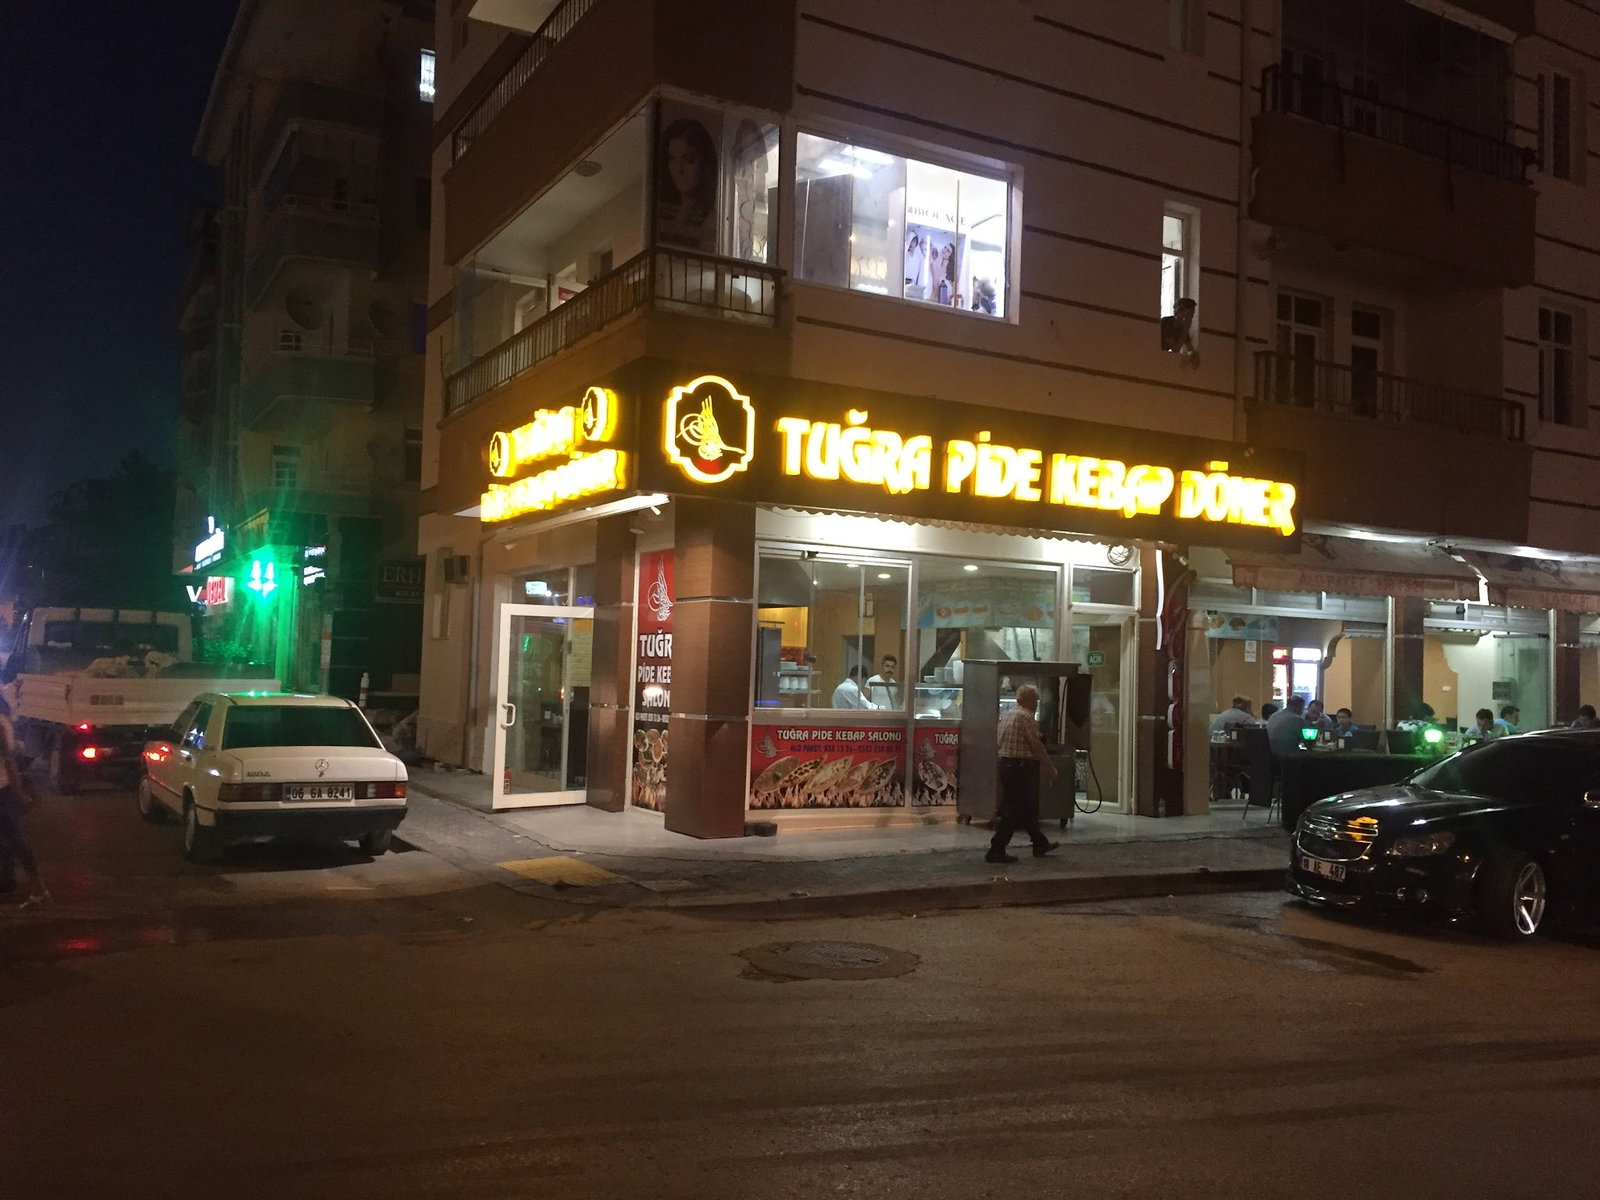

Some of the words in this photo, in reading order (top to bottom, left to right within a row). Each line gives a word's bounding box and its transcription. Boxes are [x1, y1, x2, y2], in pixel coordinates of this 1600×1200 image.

[777, 408, 933, 495] TUĞRA
[945, 430, 1042, 502] PİDE
[1048, 453, 1175, 519] KEBAP
[1177, 461, 1297, 537] DÖNER
[640, 628, 673, 660] TUĞR
[638, 662, 655, 683] PİDE
[642, 687, 671, 708] SALON
[777, 728, 809, 741] TUĞRA
[811, 728, 833, 741] PİDE
[835, 730, 866, 741] KEBAP
[868, 731, 901, 742] SALONU
[934, 731, 960, 745] TUĞRA
[291, 788, 304, 799] 06
[327, 786, 351, 799] 8241
